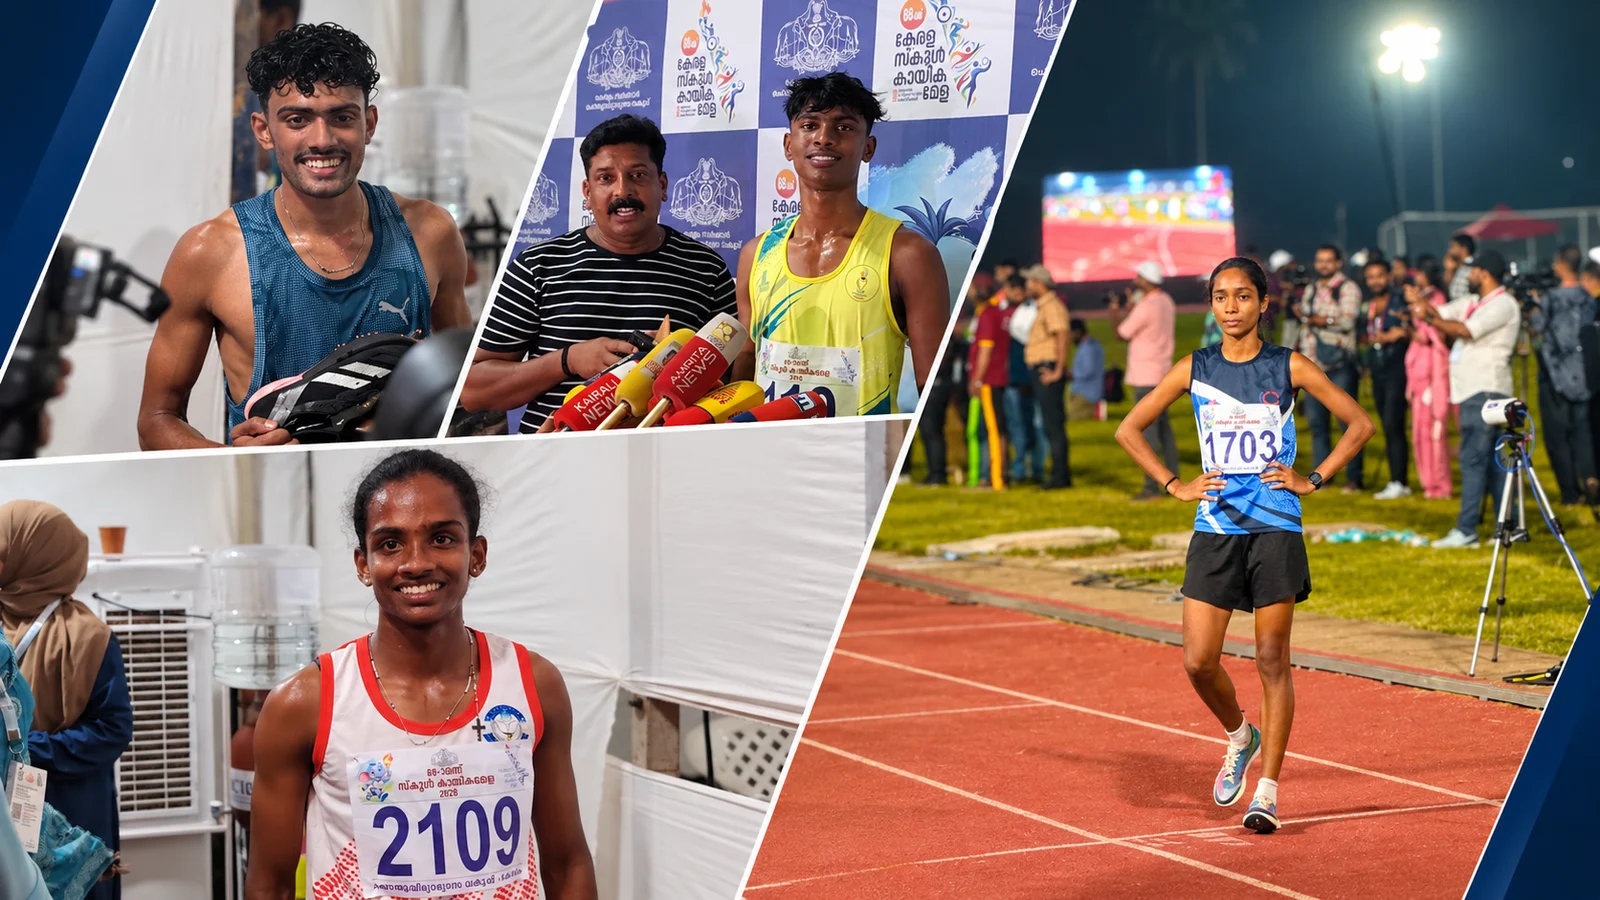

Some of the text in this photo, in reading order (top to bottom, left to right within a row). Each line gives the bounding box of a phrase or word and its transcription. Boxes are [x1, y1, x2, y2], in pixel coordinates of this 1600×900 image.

[895, 29, 936, 48] കേരള
[677, 56, 706, 71] കേരള
[893, 64, 947, 86] കായിക
[676, 85, 715, 104] കായിക
[922, 84, 949, 103] മേള
[697, 102, 717, 118] മേള
[670, 346, 708, 385] AMRITA
[675, 350, 717, 394] NEWS
[573, 378, 618, 413] KAIRALI
[582, 392, 618, 425] NEW
[1205, 430, 1278, 464] 1703
[372, 795, 521, 877] 2109
